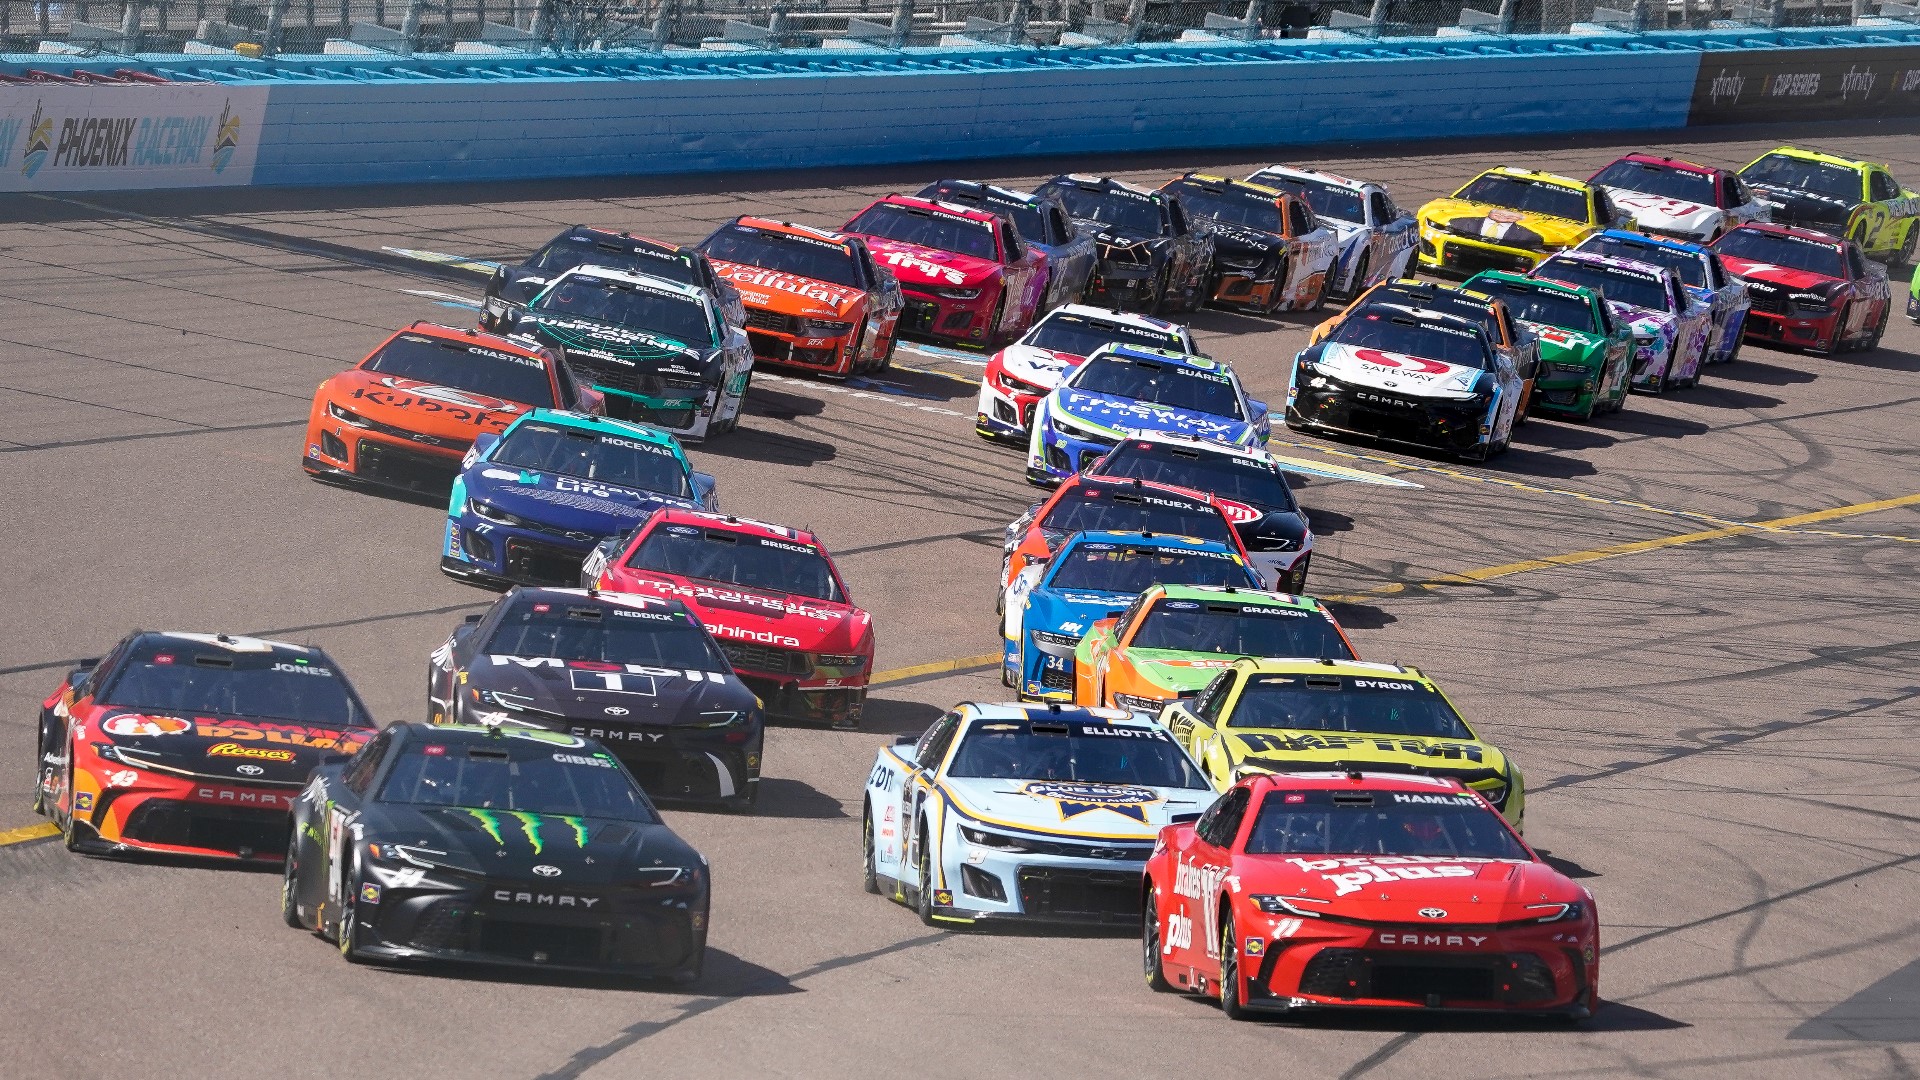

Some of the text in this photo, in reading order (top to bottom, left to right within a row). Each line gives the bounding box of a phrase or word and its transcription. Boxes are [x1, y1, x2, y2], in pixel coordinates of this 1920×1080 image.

[1710, 68, 1746, 105] xfinity
[1772, 73, 1821, 96] CUP SERIES
[1841, 65, 1878, 100] xfinity
[54, 116, 213, 167] PHOENIX RACEWAY
[1676, 169, 1704, 179] GRALA
[1109, 189, 1150, 202] BURTON
[1324, 185, 1359, 198] SMITH
[1545, 184, 1583, 197] DILLON
[986, 196, 1028, 210] WALLACE
[932, 210, 980, 226] STENHOUSE
[1862, 211, 1886, 249] 2
[633, 247, 679, 262] BLANEY
[1606, 267, 1654, 281] BOWMAN
[1537, 286, 1580, 300] LOGANO
[1120, 326, 1168, 341] LARSON
[468, 346, 541, 369] CHASTAIN
[1361, 362, 1437, 383] SAFEWAY
[1356, 392, 1419, 409] CAMRY
[1069, 393, 1231, 433] Freeway
[601, 436, 674, 458] HOCEVAR
[1232, 457, 1267, 470] BELL
[556, 481, 610, 498] Life
[1142, 496, 1194, 511] TRUEX
[1196, 506, 1219, 516] JR.
[760, 539, 815, 555] BRISCOE
[1157, 546, 1231, 561] MCDOWELL
[613, 609, 673, 622] REDDICK
[1241, 606, 1309, 619] GRAGSON
[702, 623, 800, 647] ahindra
[271, 662, 333, 677] JONES
[1046, 655, 1064, 670] 34
[1355, 679, 1414, 691] BYRON
[571, 727, 664, 743] CAMRY
[1082, 726, 1155, 739] ELLIOTT
[210, 743, 293, 760] Reese's
[552, 752, 611, 768] GIBBS
[111, 769, 138, 787] 43
[1029, 784, 1153, 799] BLUE BOOK
[1393, 793, 1474, 807] HAMLIN
[1173, 851, 1201, 900] brakes
[1321, 865, 1475, 897] plus
[493, 890, 600, 908] CAMRY
[1163, 903, 1193, 955] plus
[1379, 933, 1488, 947] CAMRY
